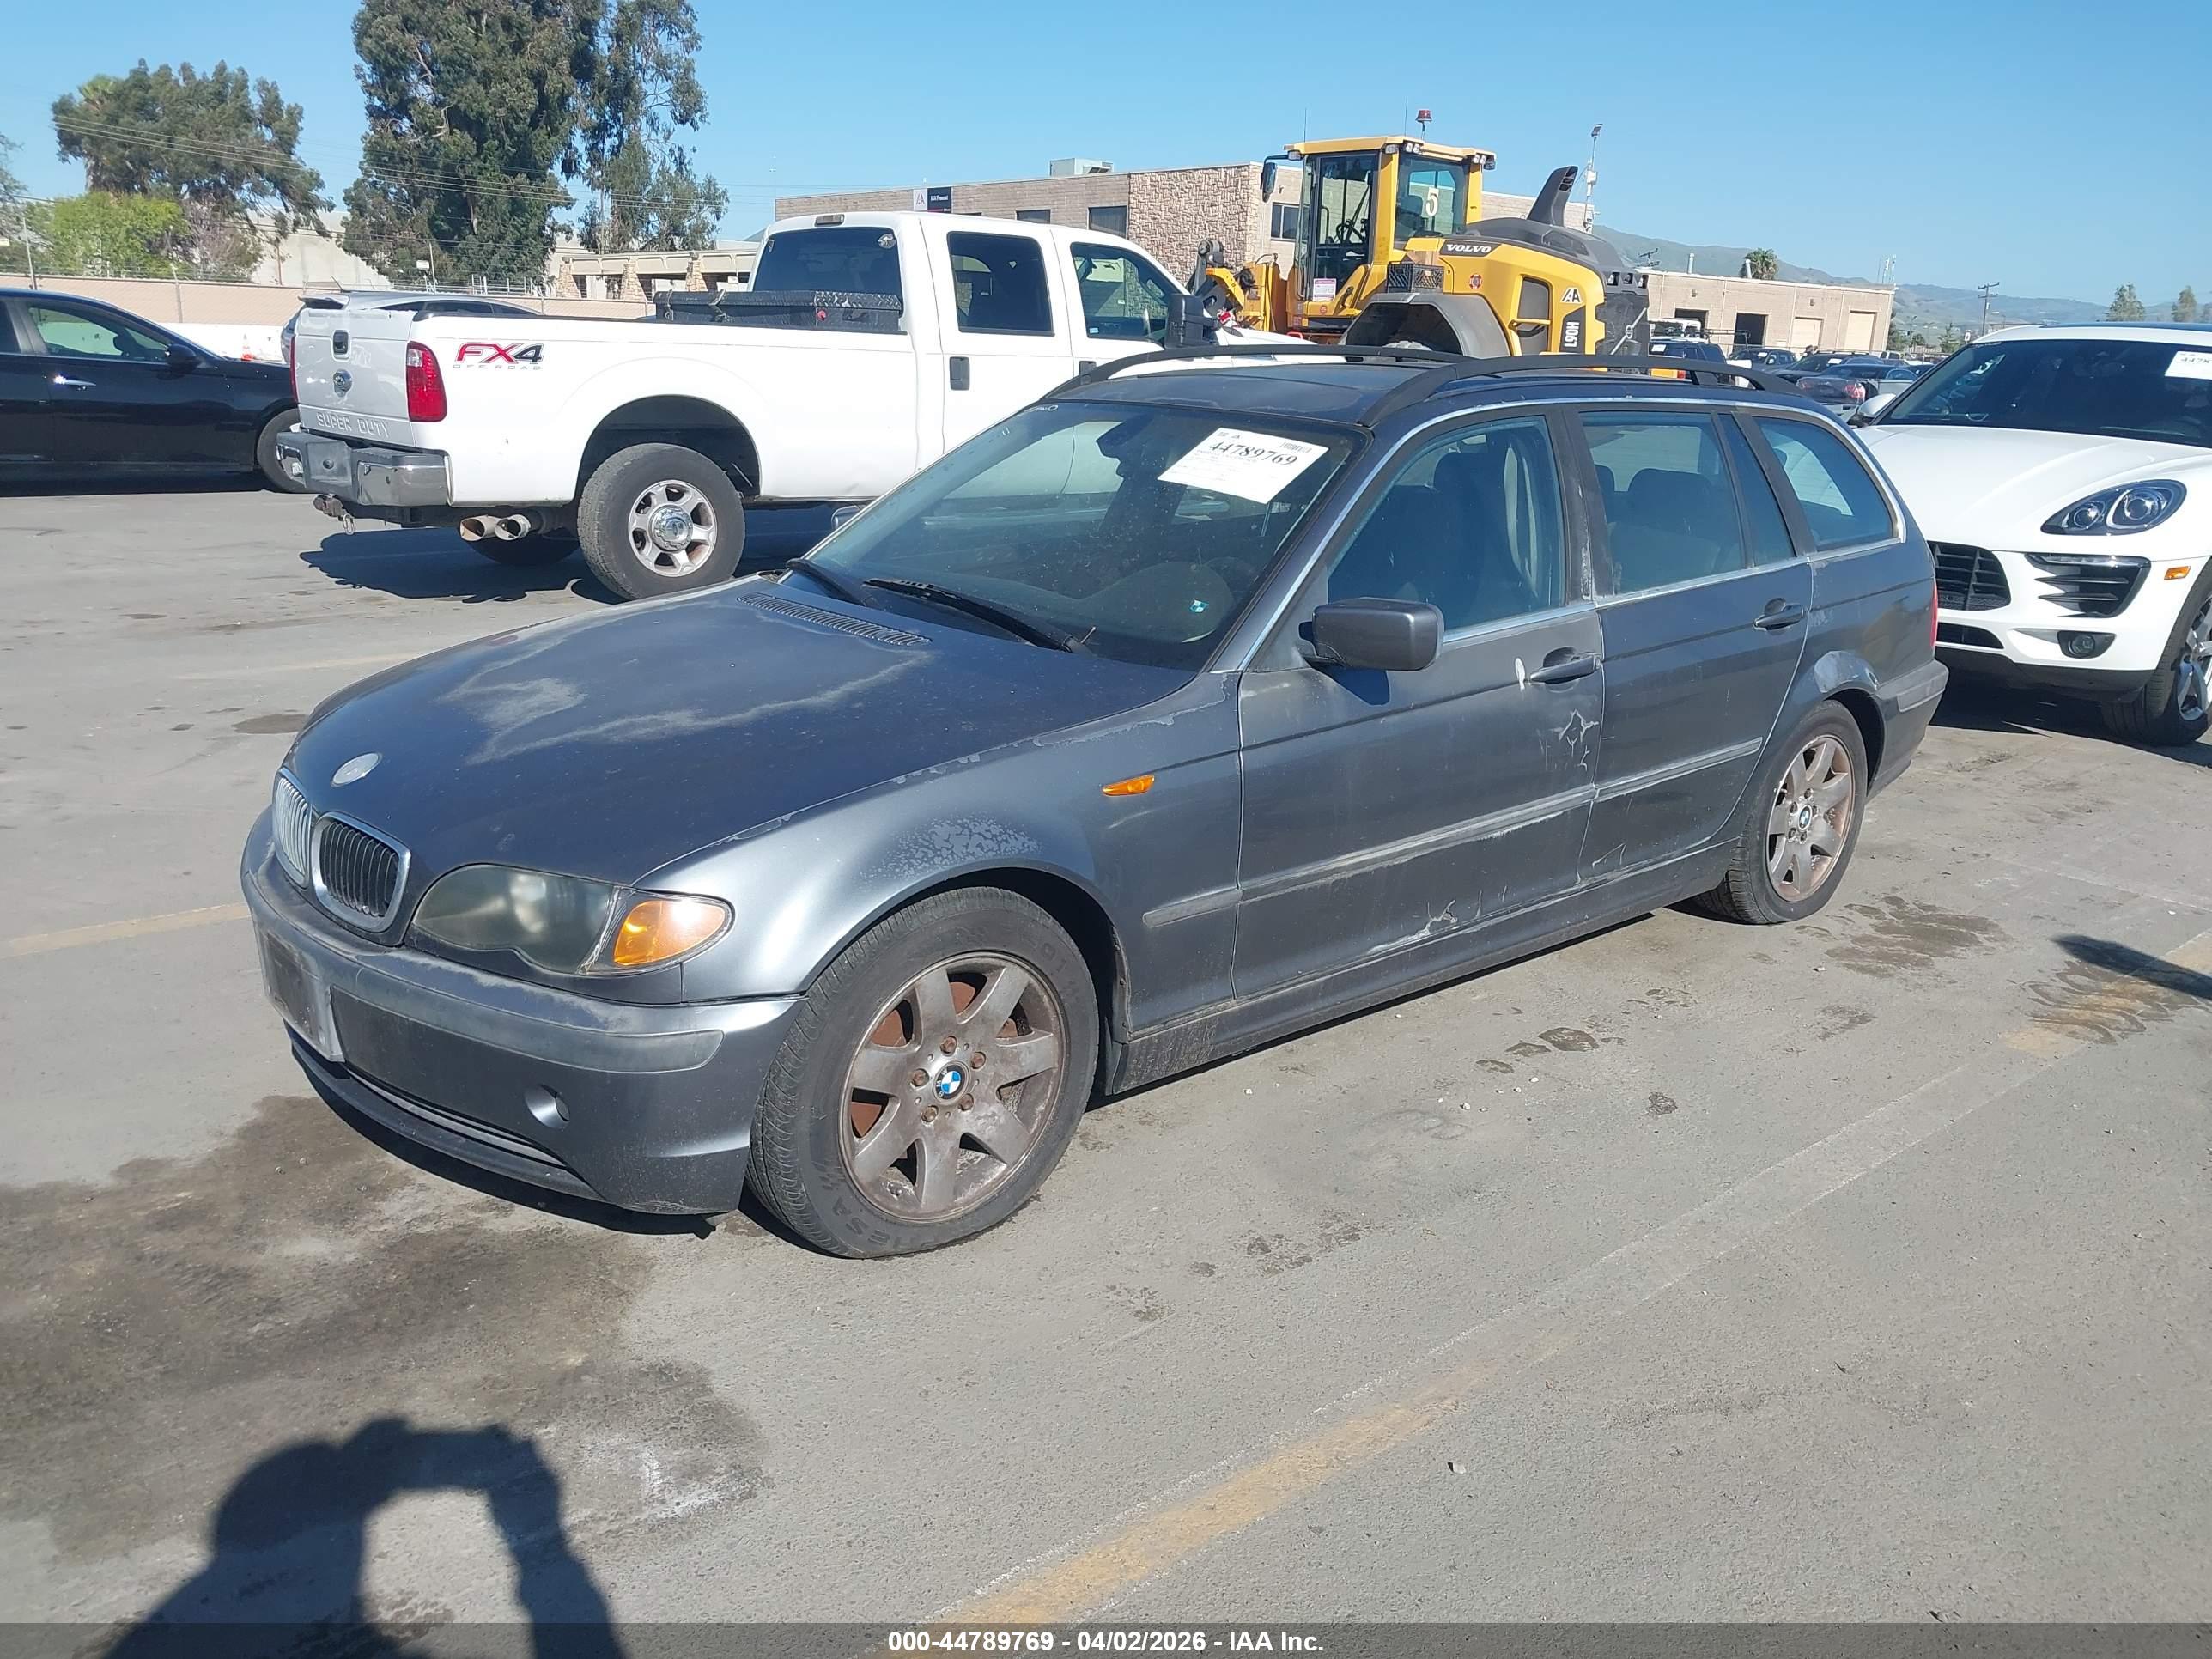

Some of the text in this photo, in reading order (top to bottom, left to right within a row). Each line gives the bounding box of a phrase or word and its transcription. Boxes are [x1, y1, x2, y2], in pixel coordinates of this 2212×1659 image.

[1426, 186, 1439, 216] 5
[1446, 244, 1492, 253] VOLVO
[1564, 321, 1580, 348] L90H
[454, 342, 545, 365] FX4
[315, 412, 390, 438] SUPER DUTY
[1208, 441, 1299, 466] 44789769
